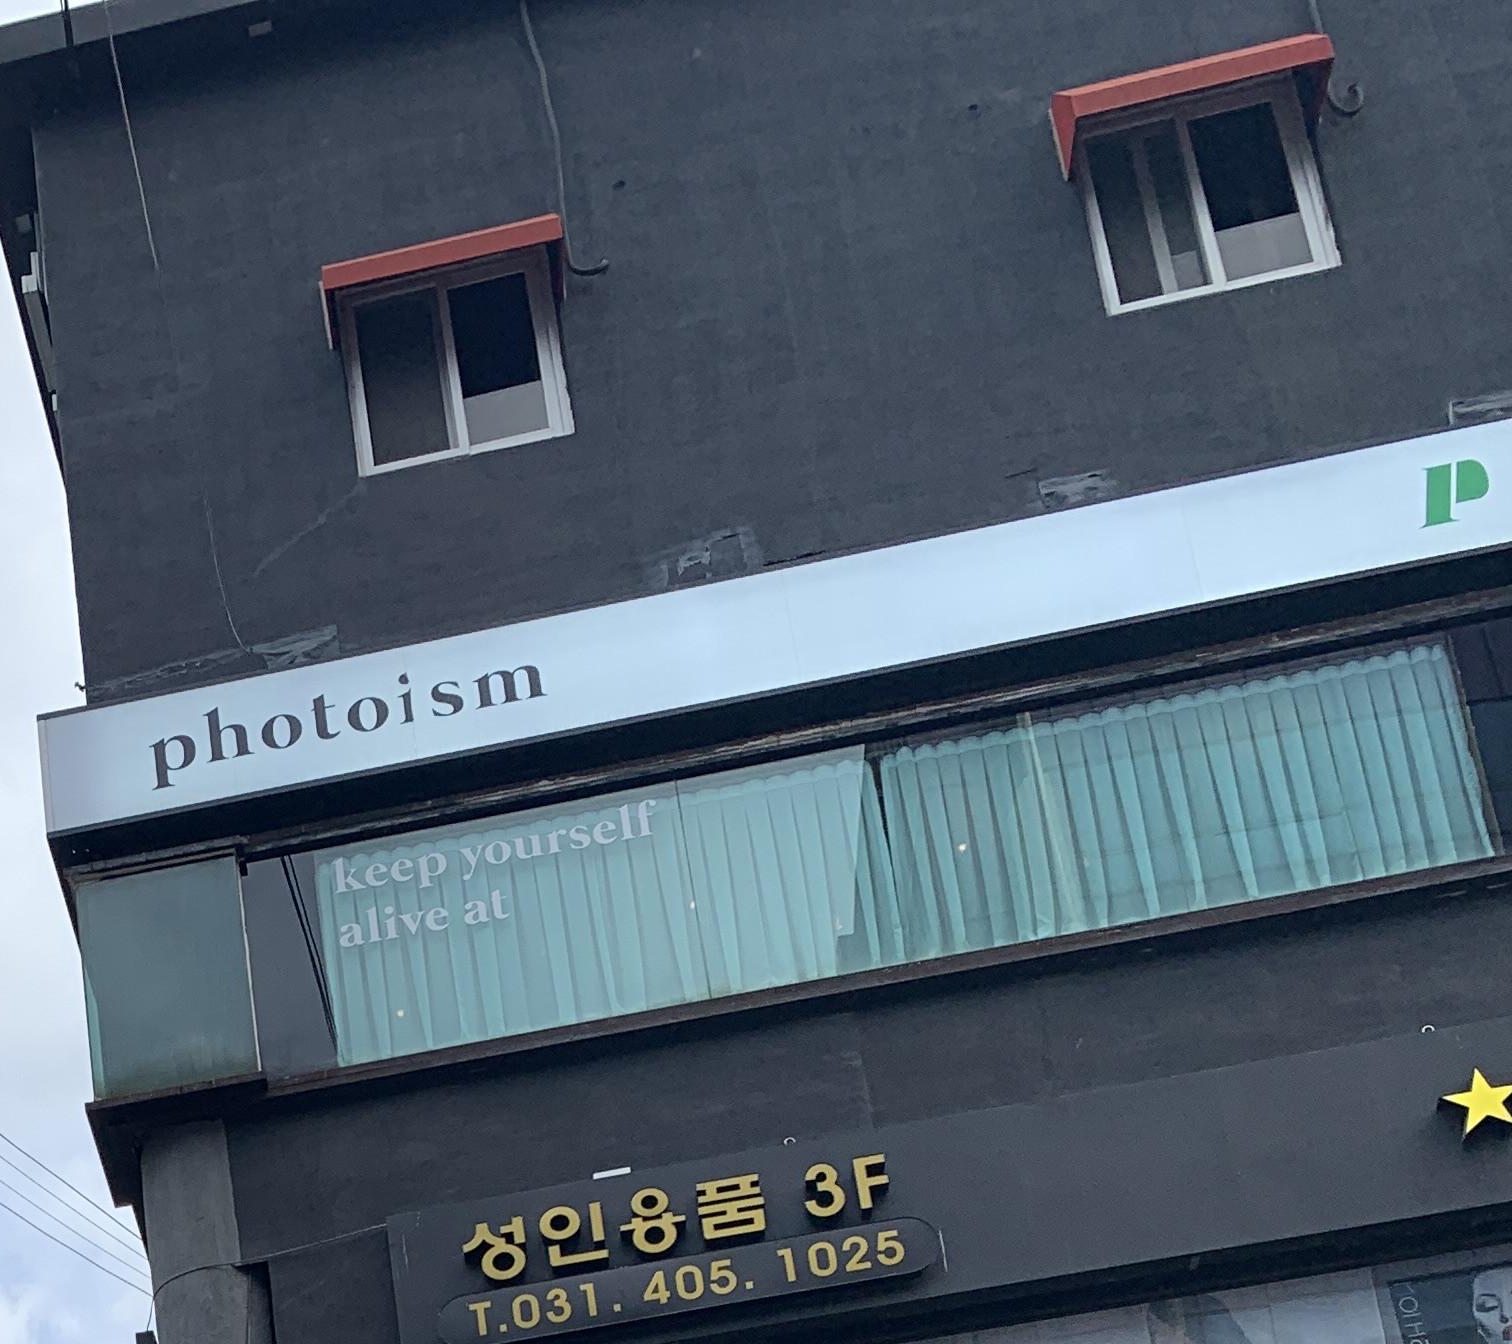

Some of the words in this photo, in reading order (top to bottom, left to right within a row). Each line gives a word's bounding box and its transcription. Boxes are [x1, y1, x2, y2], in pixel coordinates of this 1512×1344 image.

[148, 655, 546, 790] photoism
[335, 852, 448, 894] keep
[459, 799, 657, 880] yourself
[339, 905, 449, 948] alive
[464, 889, 510, 925] at
[460, 1172, 765, 1284] 성인용품
[803, 1152, 889, 1219] 3F
[776, 1227, 906, 1287] 1025
